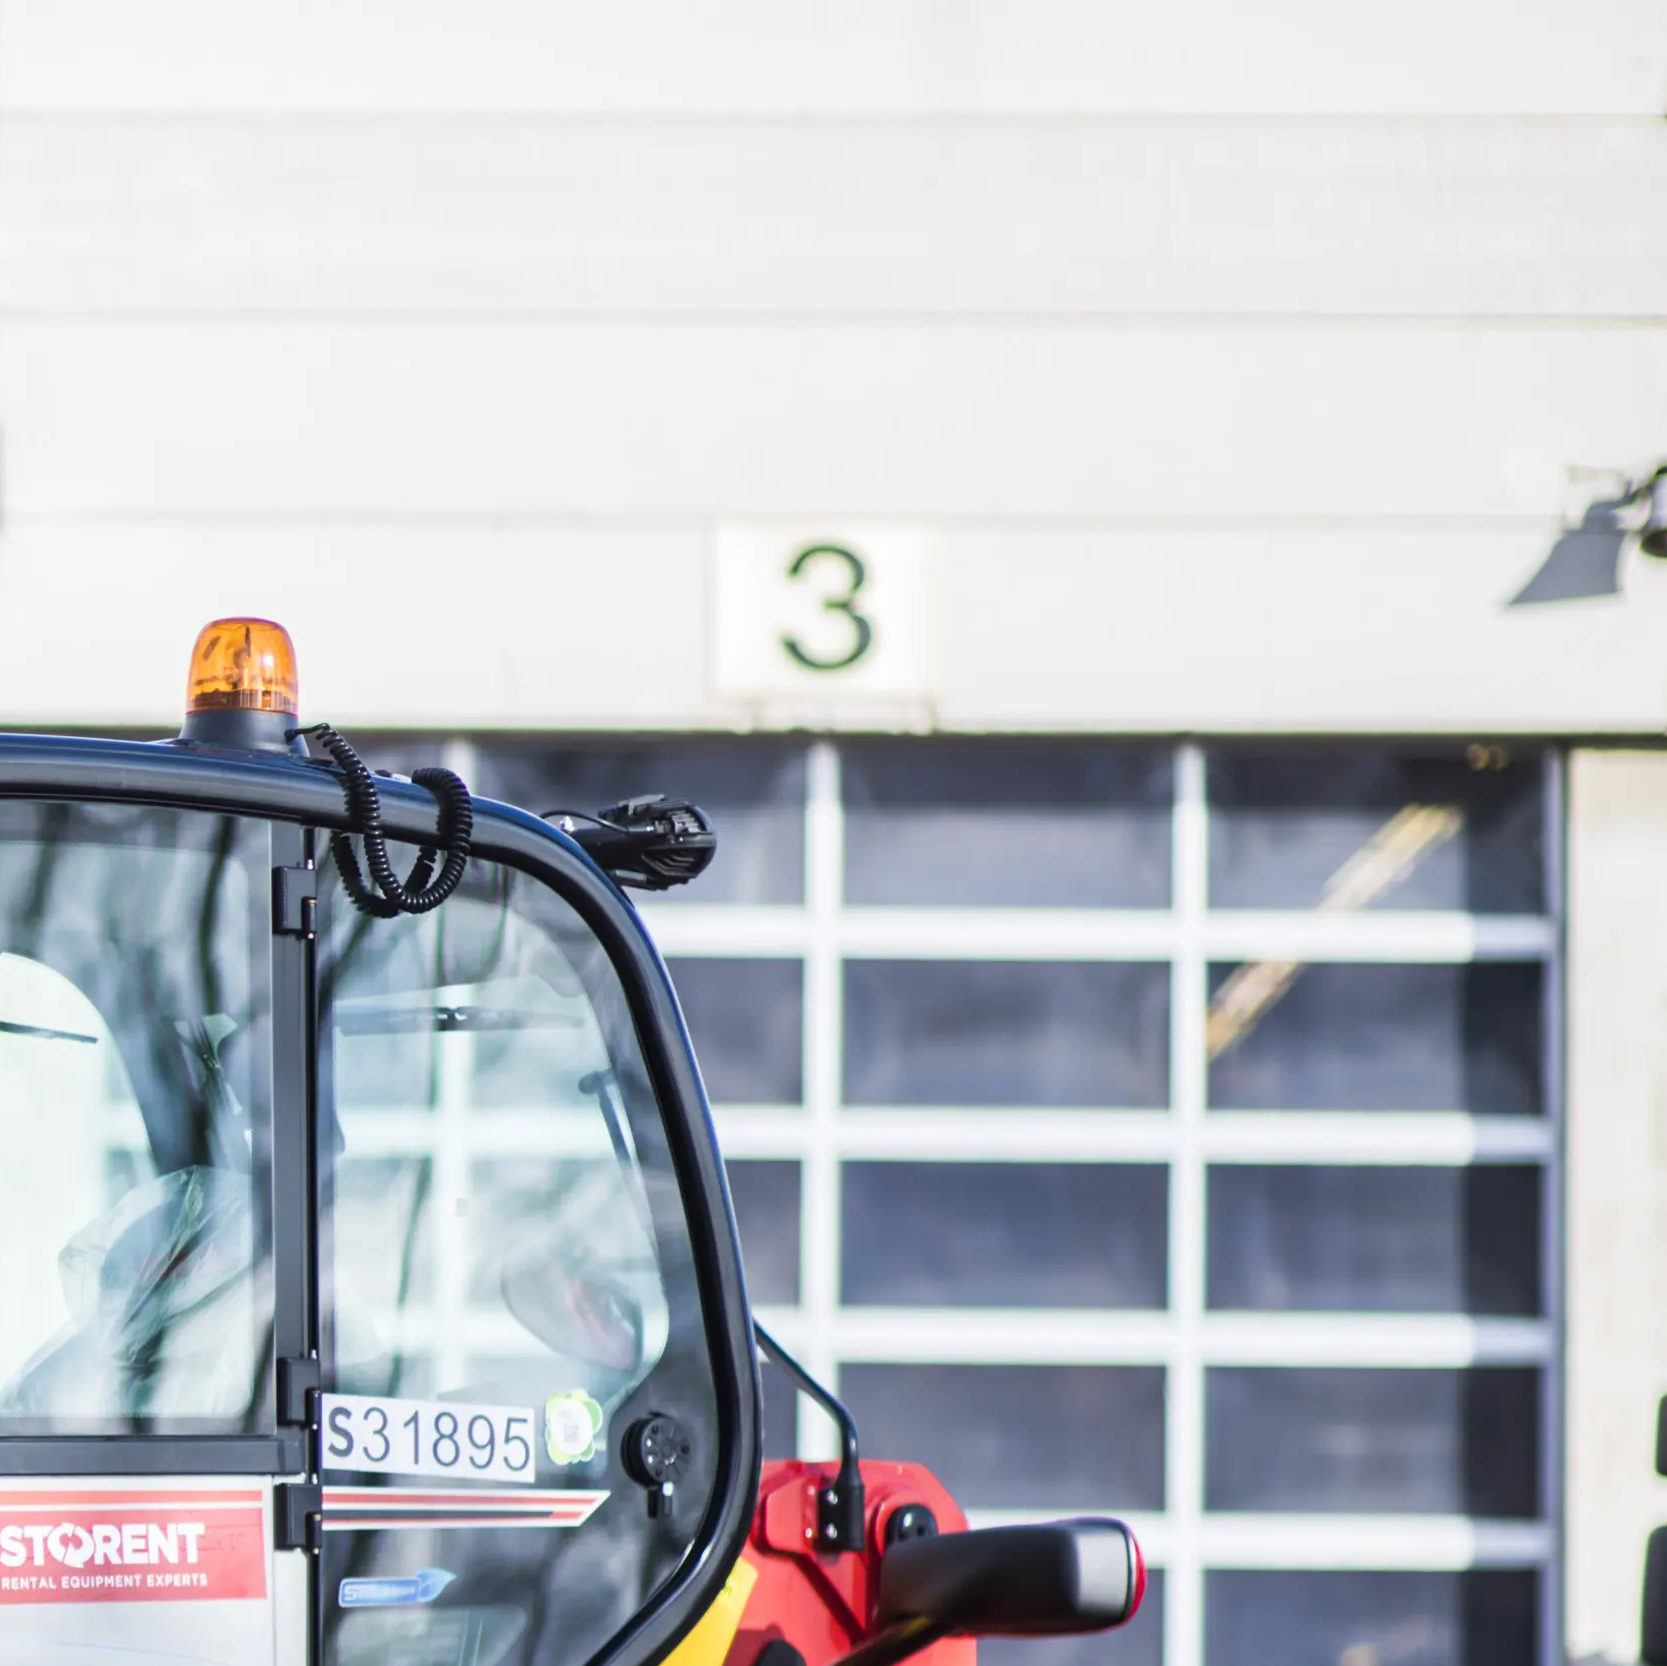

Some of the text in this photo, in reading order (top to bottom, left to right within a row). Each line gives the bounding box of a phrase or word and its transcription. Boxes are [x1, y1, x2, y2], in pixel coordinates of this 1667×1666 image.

[781, 544, 871, 670] 3
[328, 1406, 531, 1471] S31895
[0, 1522, 205, 1568] STORENT
[2, 1572, 208, 1590] RENTAL EQUIPMENT EXPERTS
